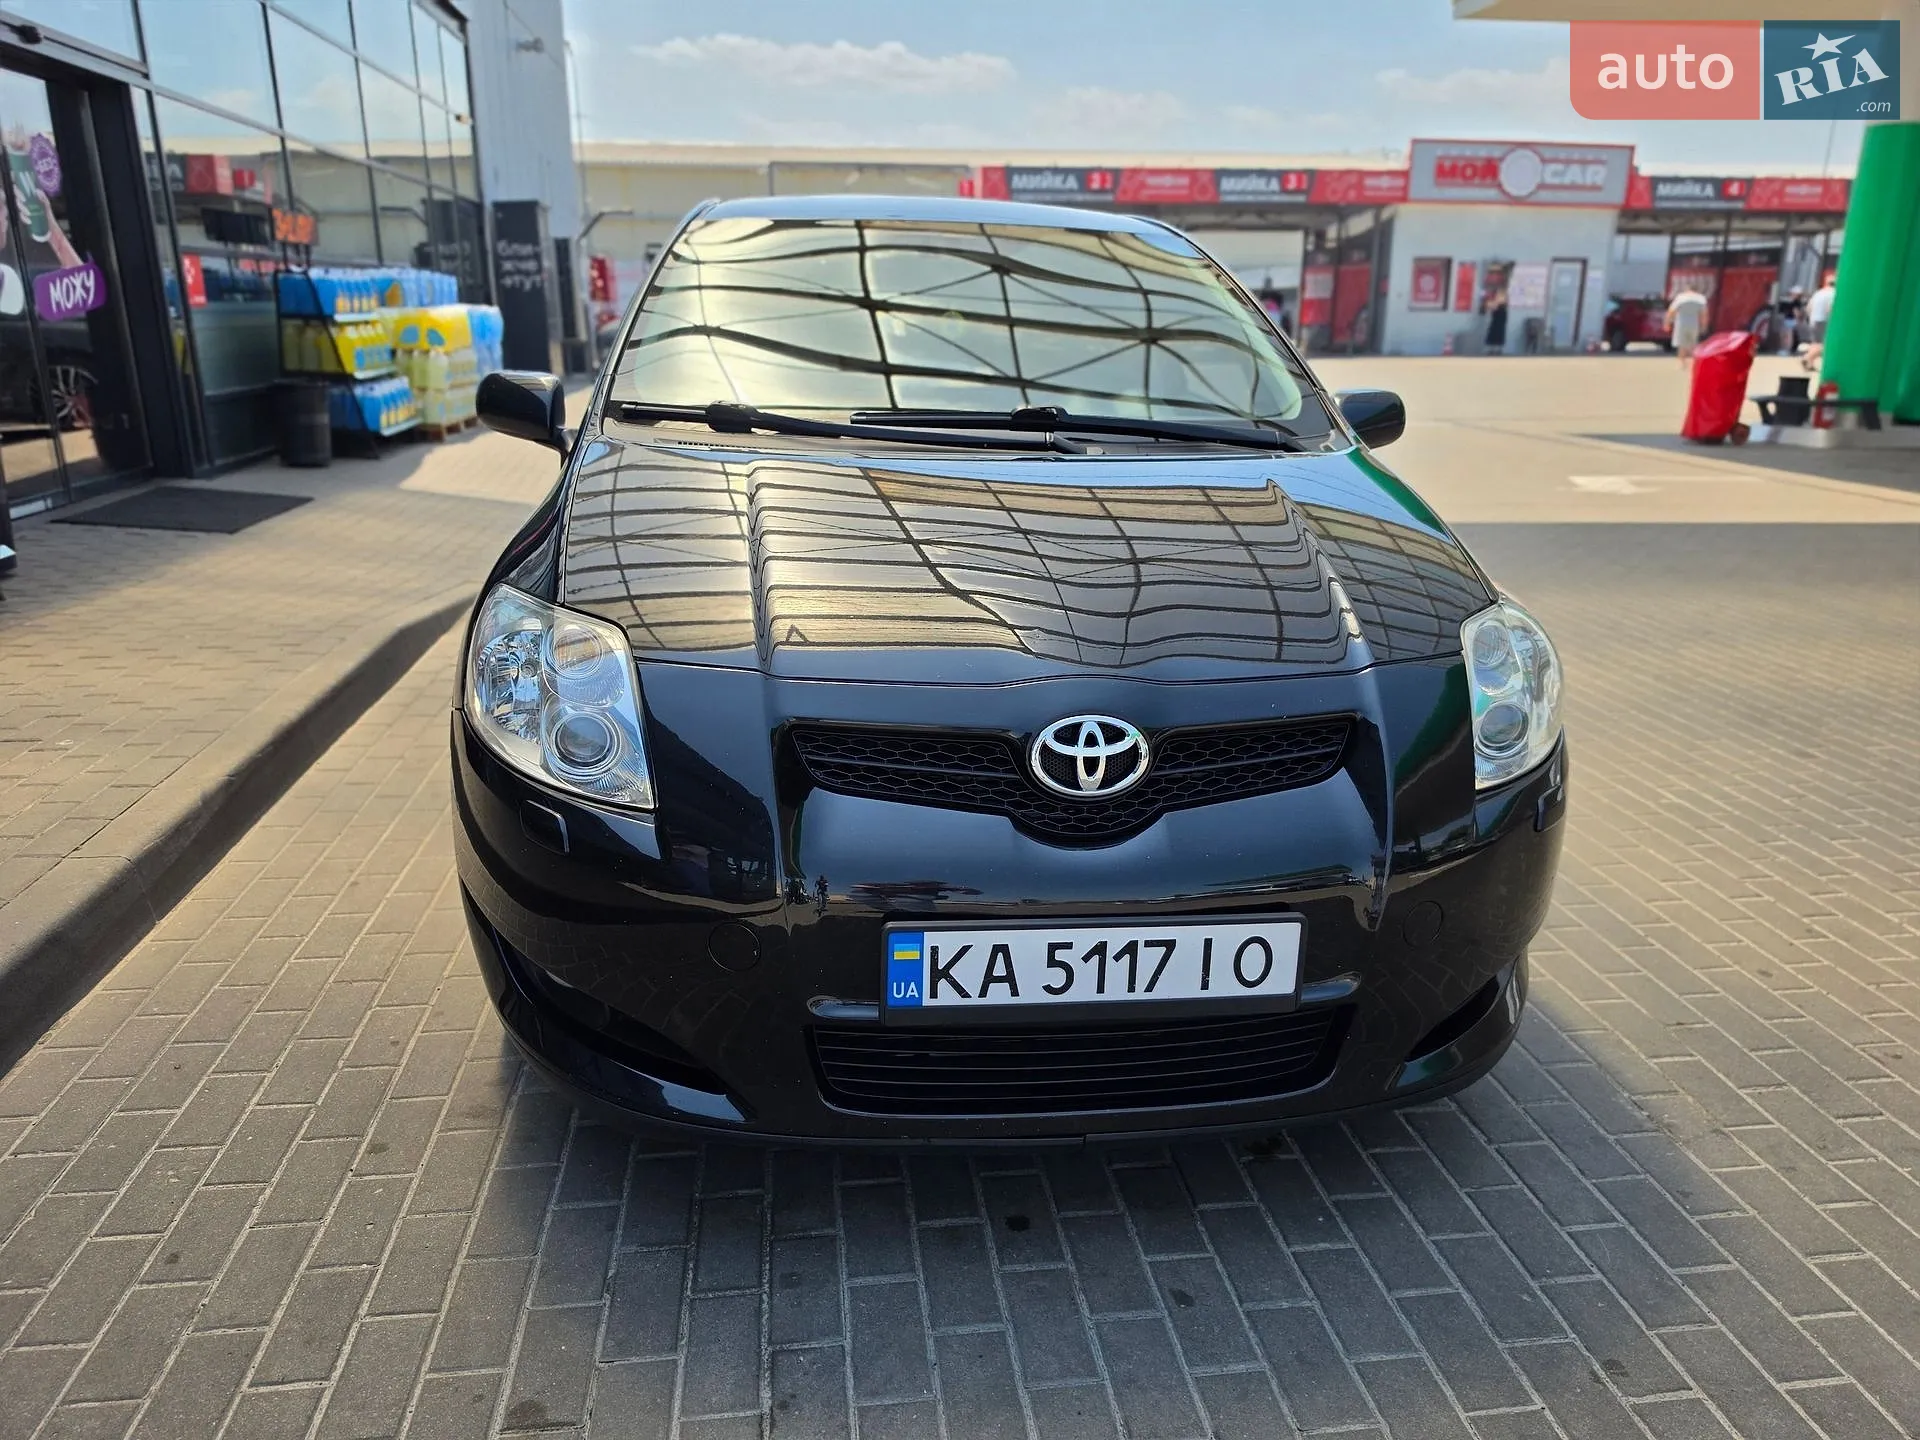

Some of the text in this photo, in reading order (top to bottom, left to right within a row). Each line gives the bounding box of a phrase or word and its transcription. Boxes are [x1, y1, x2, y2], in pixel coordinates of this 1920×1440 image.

[928, 944, 1021, 999] KA
[1041, 938, 1177, 996] 5117
[893, 981, 919, 999] UA
